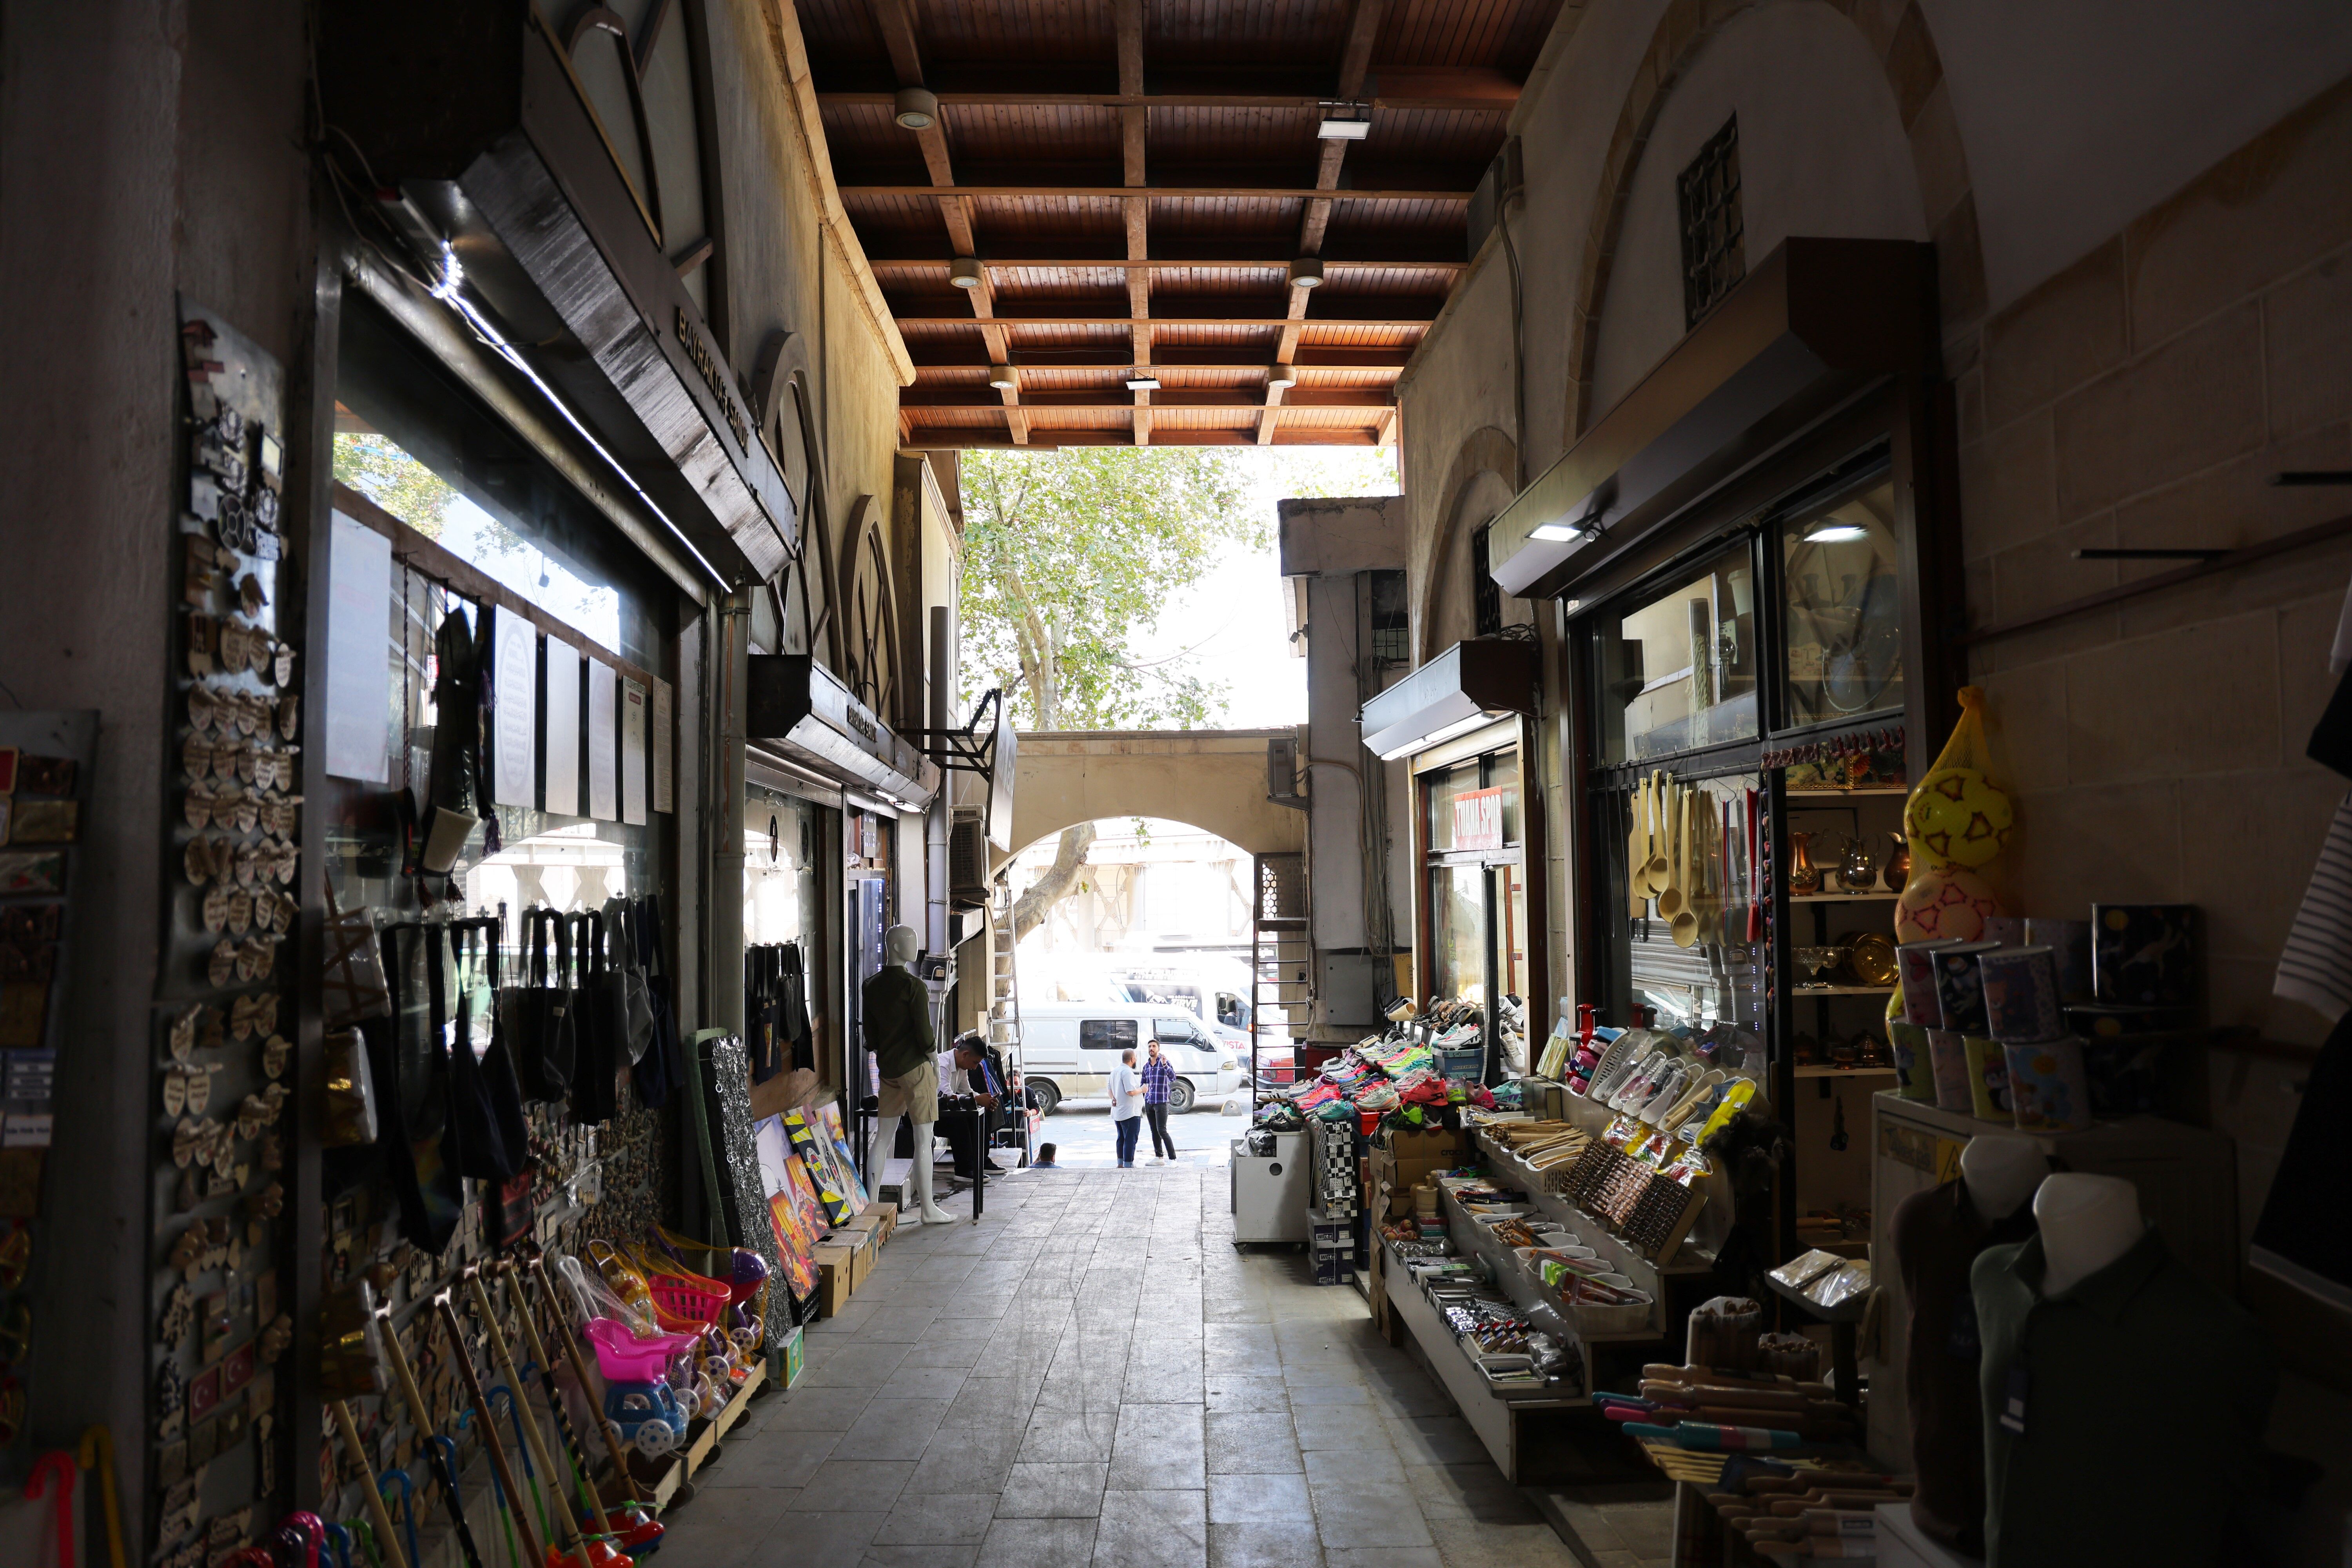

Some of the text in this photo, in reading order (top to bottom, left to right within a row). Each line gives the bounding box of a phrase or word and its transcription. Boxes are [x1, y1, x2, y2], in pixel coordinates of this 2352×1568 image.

[679, 308, 728, 417] BAYRAKTAR
[1455, 794, 1502, 837] TUANA SPOR
